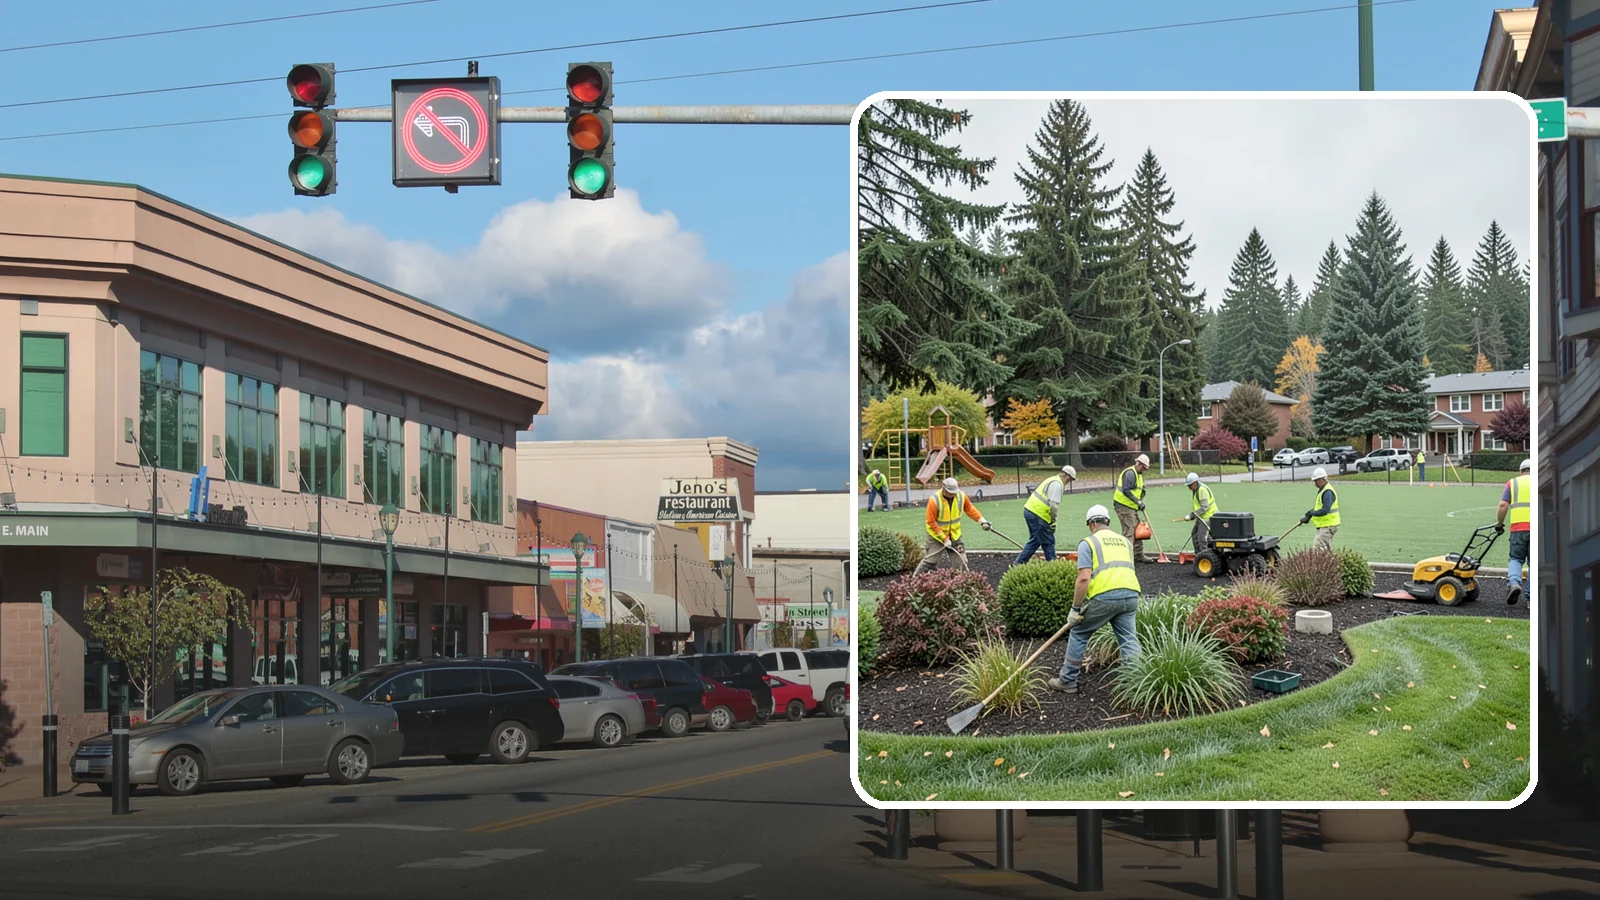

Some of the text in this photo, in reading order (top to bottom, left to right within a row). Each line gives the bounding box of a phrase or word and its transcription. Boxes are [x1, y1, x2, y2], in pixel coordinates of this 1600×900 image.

[669, 480, 727, 495] Jeno's
[665, 496, 731, 508] restaurant
[658, 509, 681, 520] Italian
[686, 509, 714, 520] American
[714, 509, 738, 520] Cuisine
[2, 525, 49, 536] E. MAIN
[797, 607, 828, 617] Street
[791, 619, 823, 627] lass
